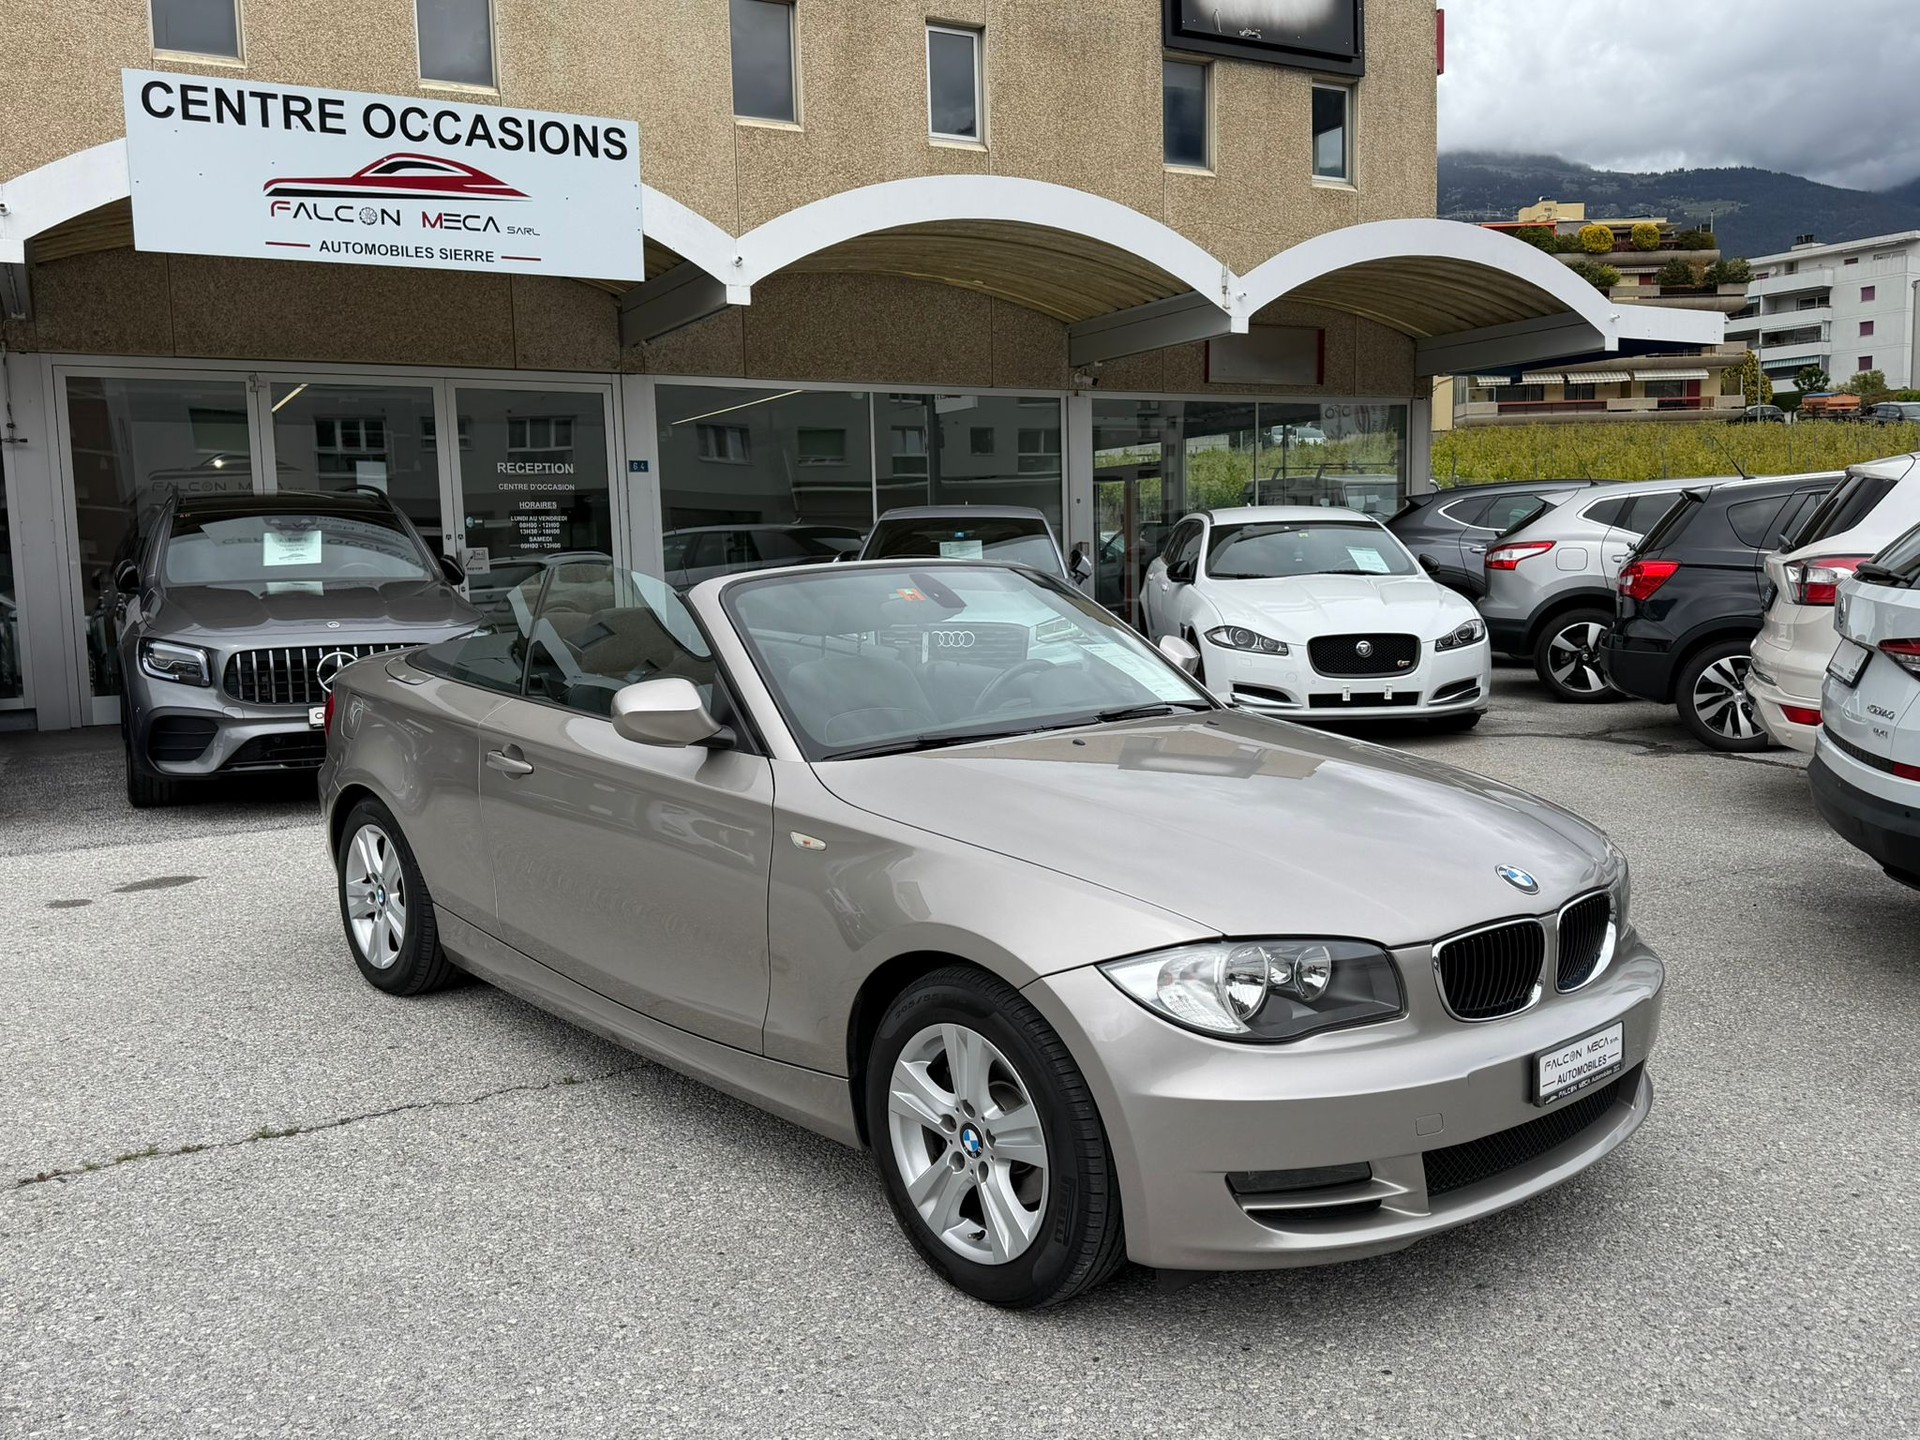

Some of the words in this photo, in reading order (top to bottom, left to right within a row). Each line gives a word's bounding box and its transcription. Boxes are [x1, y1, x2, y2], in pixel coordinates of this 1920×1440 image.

[140, 80, 347, 135] CENTRE
[361, 102, 629, 160] OCCASIONS
[270, 200, 401, 228] FALCON
[421, 210, 501, 234] MECA
[506, 225, 541, 237] SARL
[318, 239, 434, 260] AUTOMOBILES
[438, 247, 495, 264] SIERRE
[497, 462, 574, 474] RECEPTION
[530, 483, 575, 491] D'OCCASION
[519, 501, 557, 510] HORAIRES
[1544, 1047, 1583, 1072] FALCON
[1586, 1036, 1609, 1054] MECA
[1556, 1054, 1607, 1085] AUTOMOBILES
